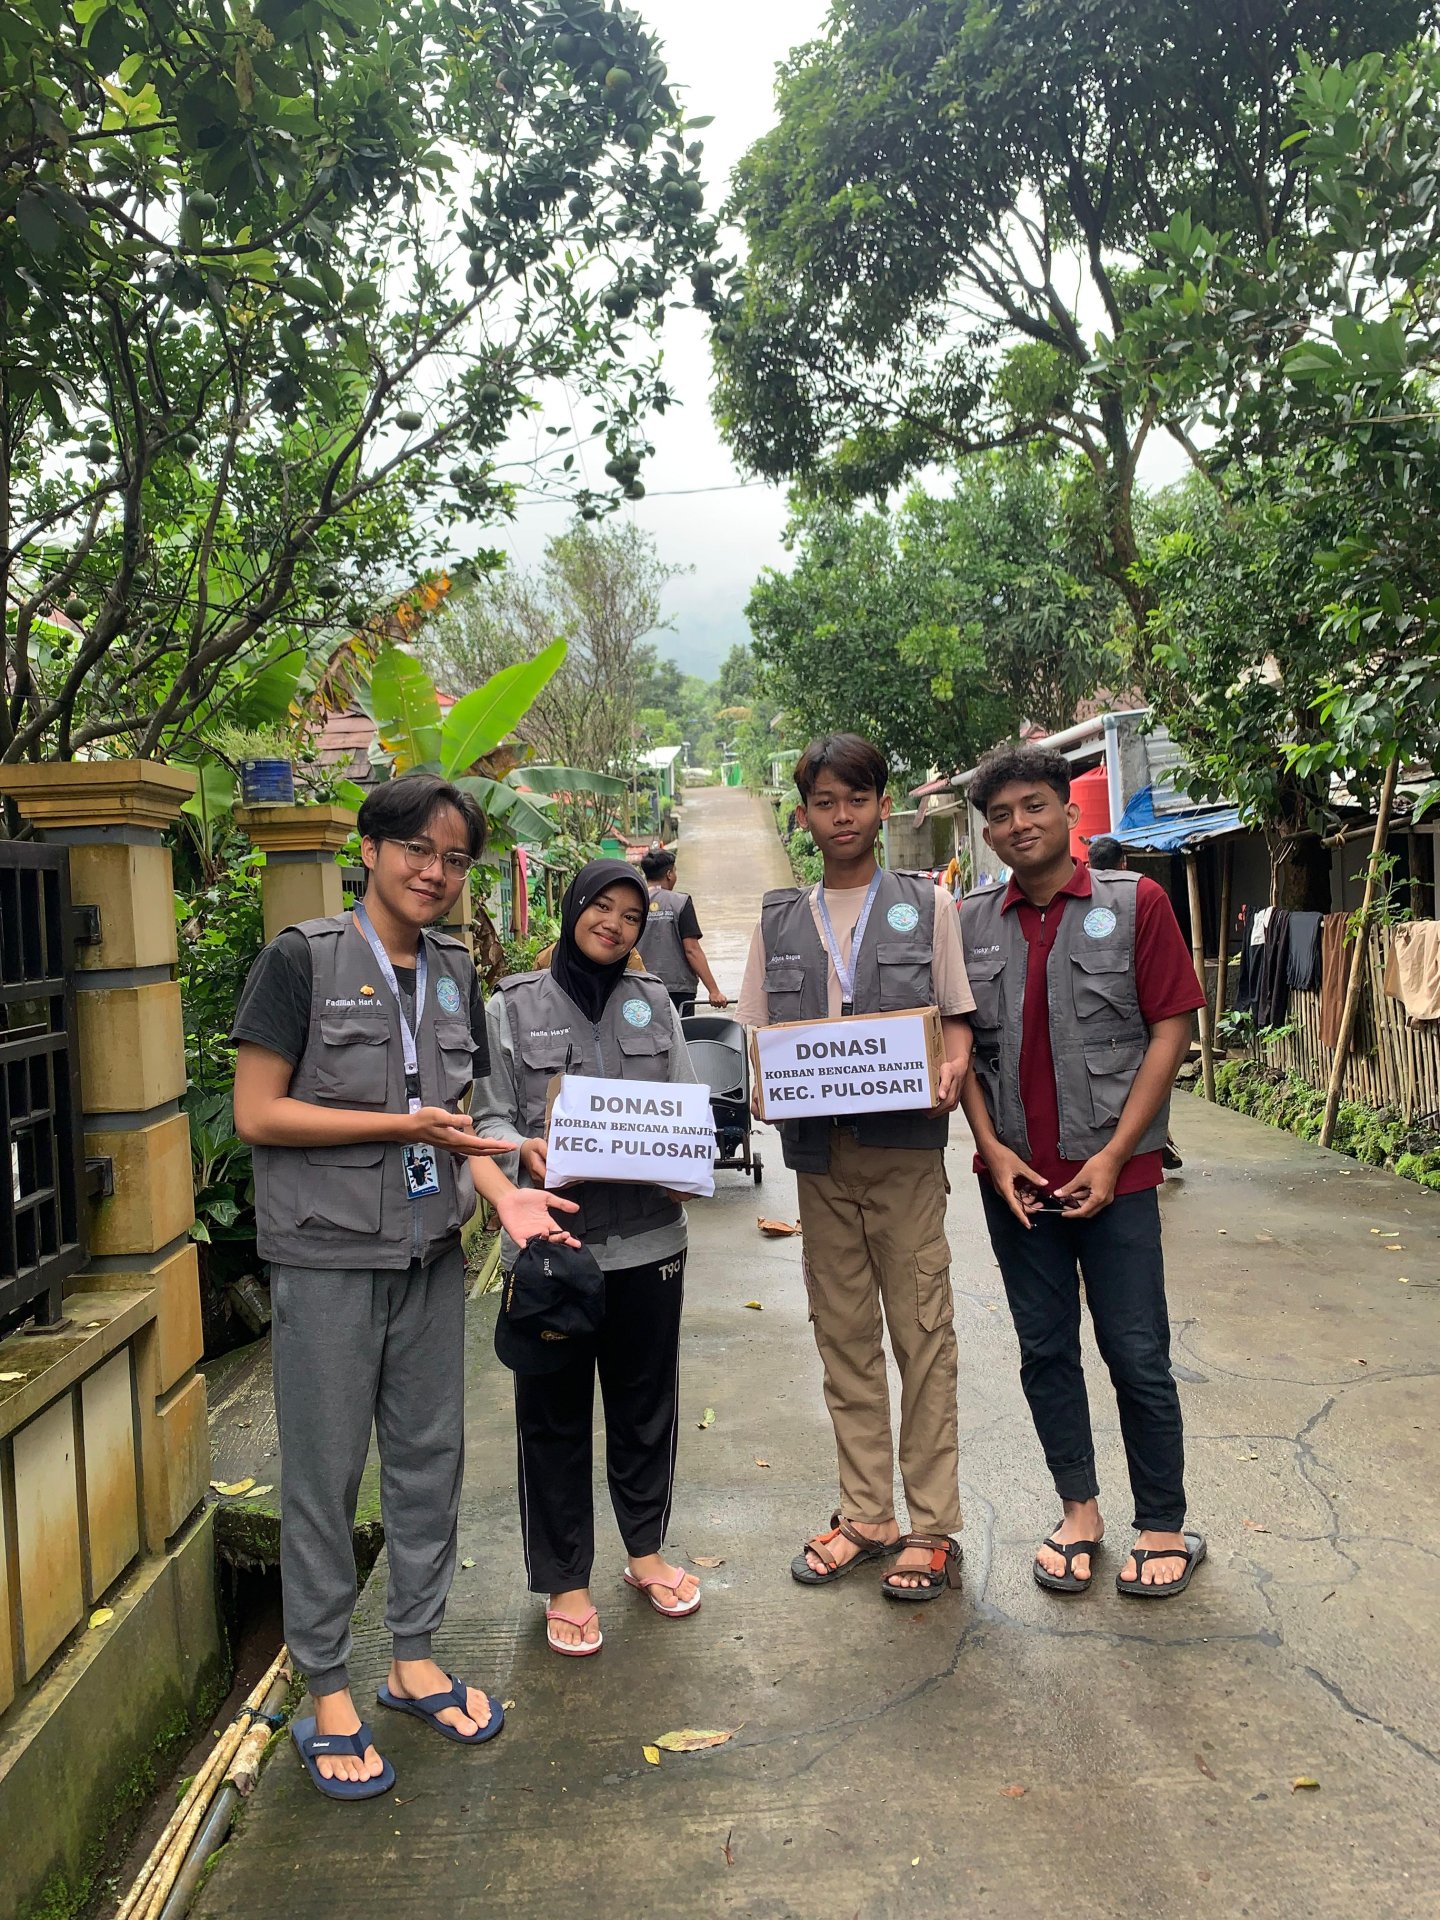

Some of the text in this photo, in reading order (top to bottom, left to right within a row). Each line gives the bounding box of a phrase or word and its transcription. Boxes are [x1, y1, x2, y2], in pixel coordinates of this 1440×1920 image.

[796, 1038, 887, 1060] DONASI
[765, 1061, 925, 1080] KORBAN BENCANA BANJIR
[769, 1078, 923, 1101] KEC. PULOSARI
[590, 1095, 683, 1117] DONASI
[554, 1118, 607, 1130] KORBAN
[610, 1122, 669, 1134] BENCANA
[555, 1136, 712, 1160] KEC. PULOSARI
[658, 1258, 681, 1281] T90
